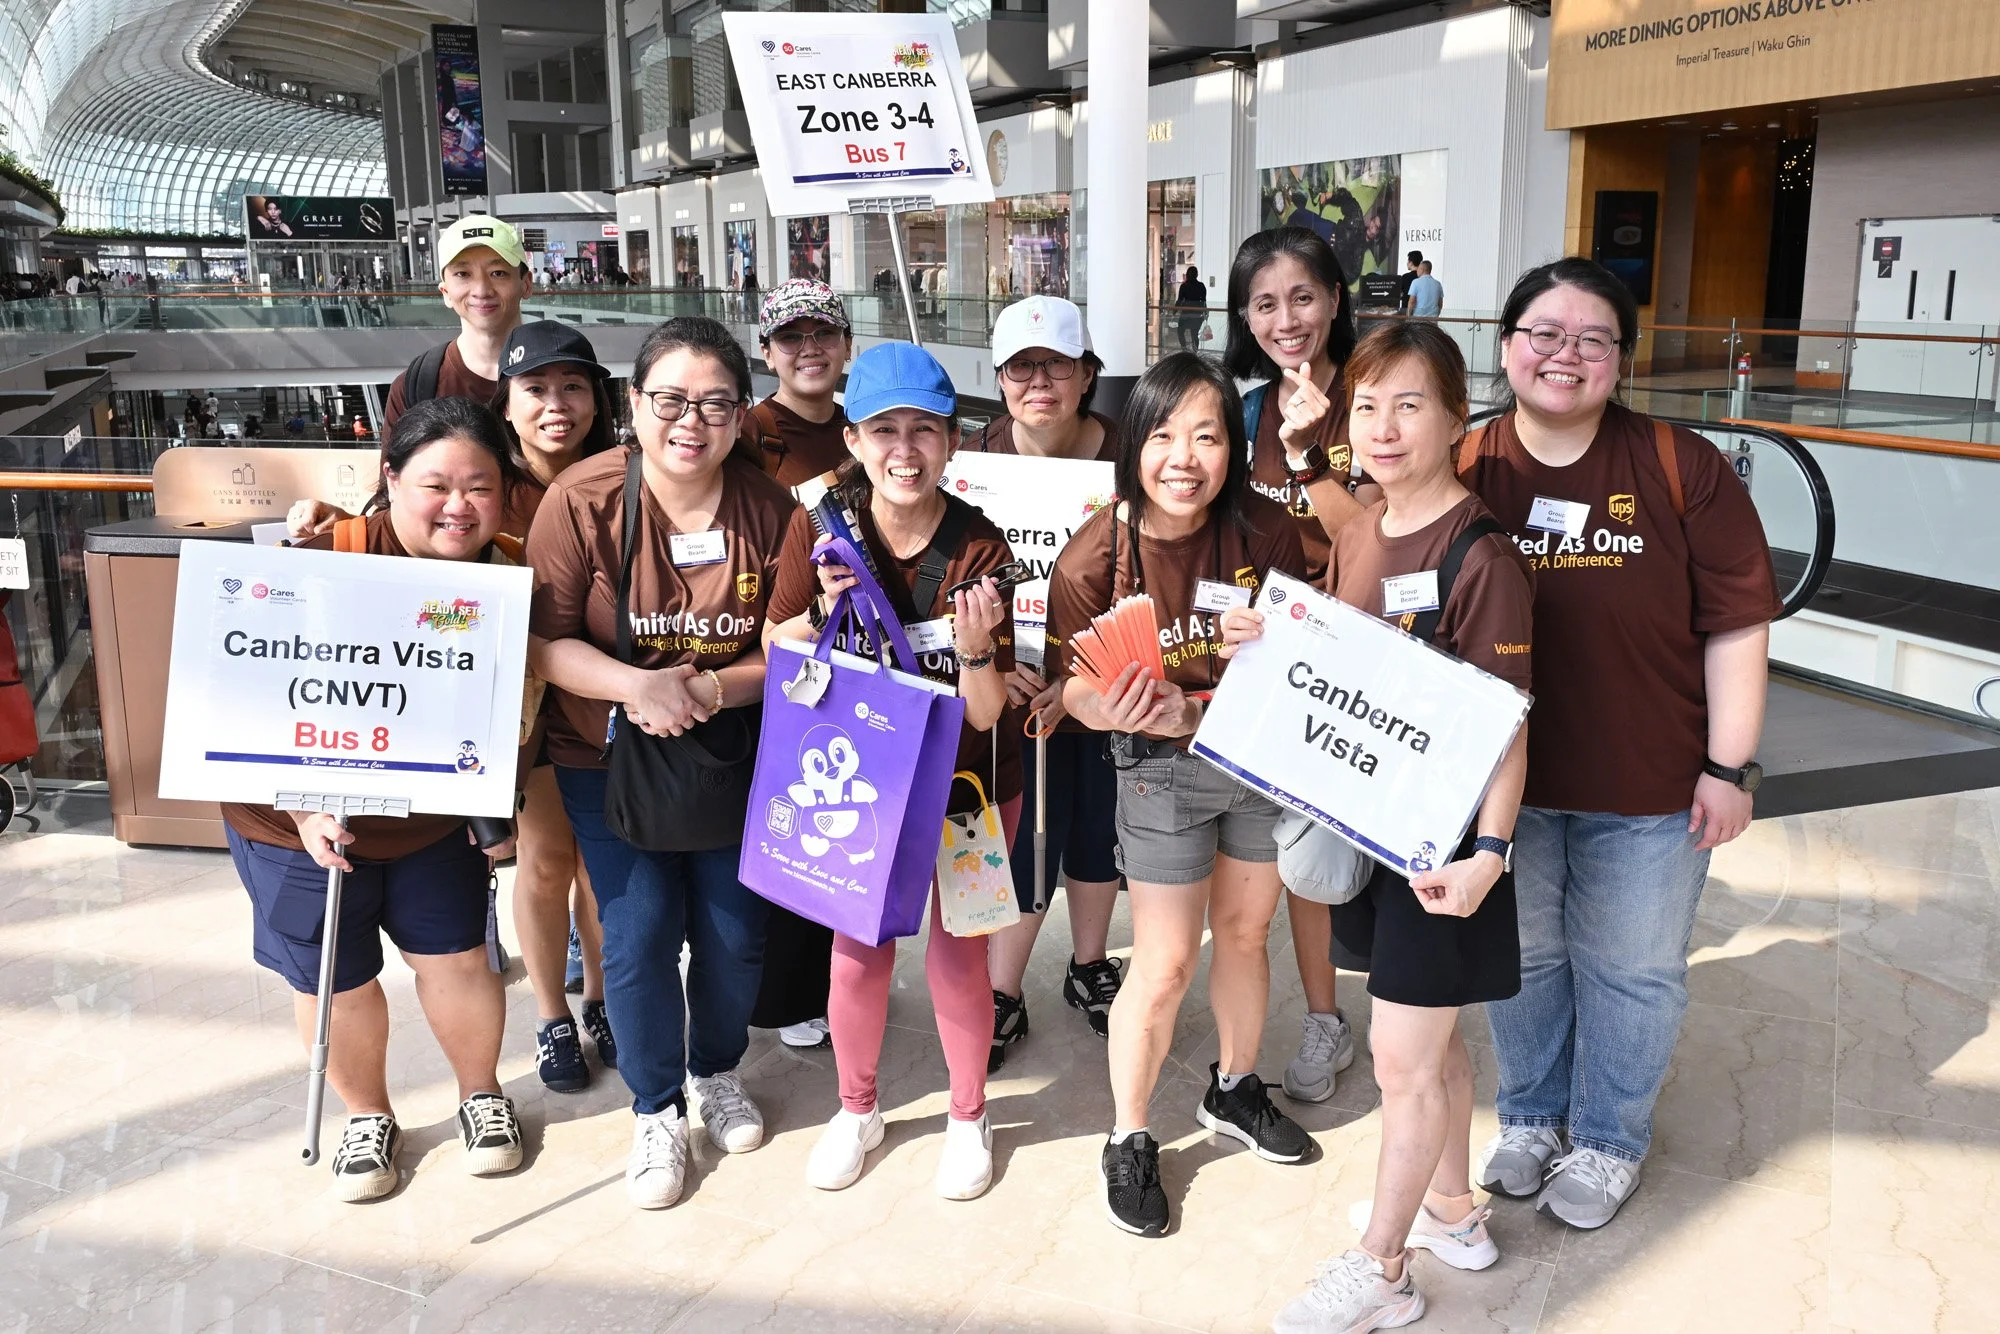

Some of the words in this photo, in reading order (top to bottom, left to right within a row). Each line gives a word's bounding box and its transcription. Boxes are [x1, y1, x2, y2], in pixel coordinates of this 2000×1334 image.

[1585, 28, 1627, 52] MORE
[1629, 17, 1684, 44] DINING
[1686, 2, 1761, 33] OPTIONS
[1676, 49, 1711, 67] Imperial
[1713, 45, 1750, 60] Treasure
[1757, 39, 1784, 53] Waku
[1786, 35, 1811, 48] Ghin
[776, 74, 826, 90] EAST
[833, 72, 937, 89] CANBERRA
[797, 105, 879, 133] Zone
[887, 102, 934, 130] 3-4
[845, 143, 890, 164] Bus
[894, 142, 906, 161] 7
[302, 214, 343, 222] GRAFF
[1405, 229, 1442, 242] VERSACE
[1330, 451, 1348, 468] ups
[969, 483, 988, 491] Cares
[1547, 510, 1566, 519] Group
[1610, 502, 1633, 519] ups
[1546, 516, 1566, 525] Bearer
[1556, 534, 1586, 555] As
[1593, 528, 1644, 554] One
[1539, 556, 1550, 569] A
[1553, 554, 1623, 569] Difference
[6, 566, 19, 576] SIT
[270, 588, 295, 597] Cares
[739, 581, 756, 598] ups
[422, 603, 456, 614] READY
[1016, 598, 1046, 615] us
[683, 612, 710, 637] As
[715, 612, 755, 636] One
[1188, 614, 1216, 640] As
[1306, 613, 1330, 630] Cares
[223, 630, 381, 666] Canberra
[392, 641, 475, 671] Vista
[682, 636, 739, 654] Difference
[1180, 646, 1189, 660] A
[288, 677, 408, 716] (CNVT)
[869, 710, 889, 723] Cares
[1287, 661, 1431, 755] Canberra
[294, 721, 359, 751] Bus
[371, 726, 390, 753] 8
[1304, 713, 1379, 777] Vista
[301, 756, 309, 765] To
[310, 758, 326, 766] Serve
[328, 758, 341, 766] with
[341, 759, 357, 767] Love
[370, 760, 385, 769] Care
[760, 841, 770, 855] To
[770, 847, 790, 864] Serve
[791, 860, 809, 872] with
[809, 865, 829, 880] Love
[829, 874, 847, 886] and
[846, 879, 868, 895] Care
